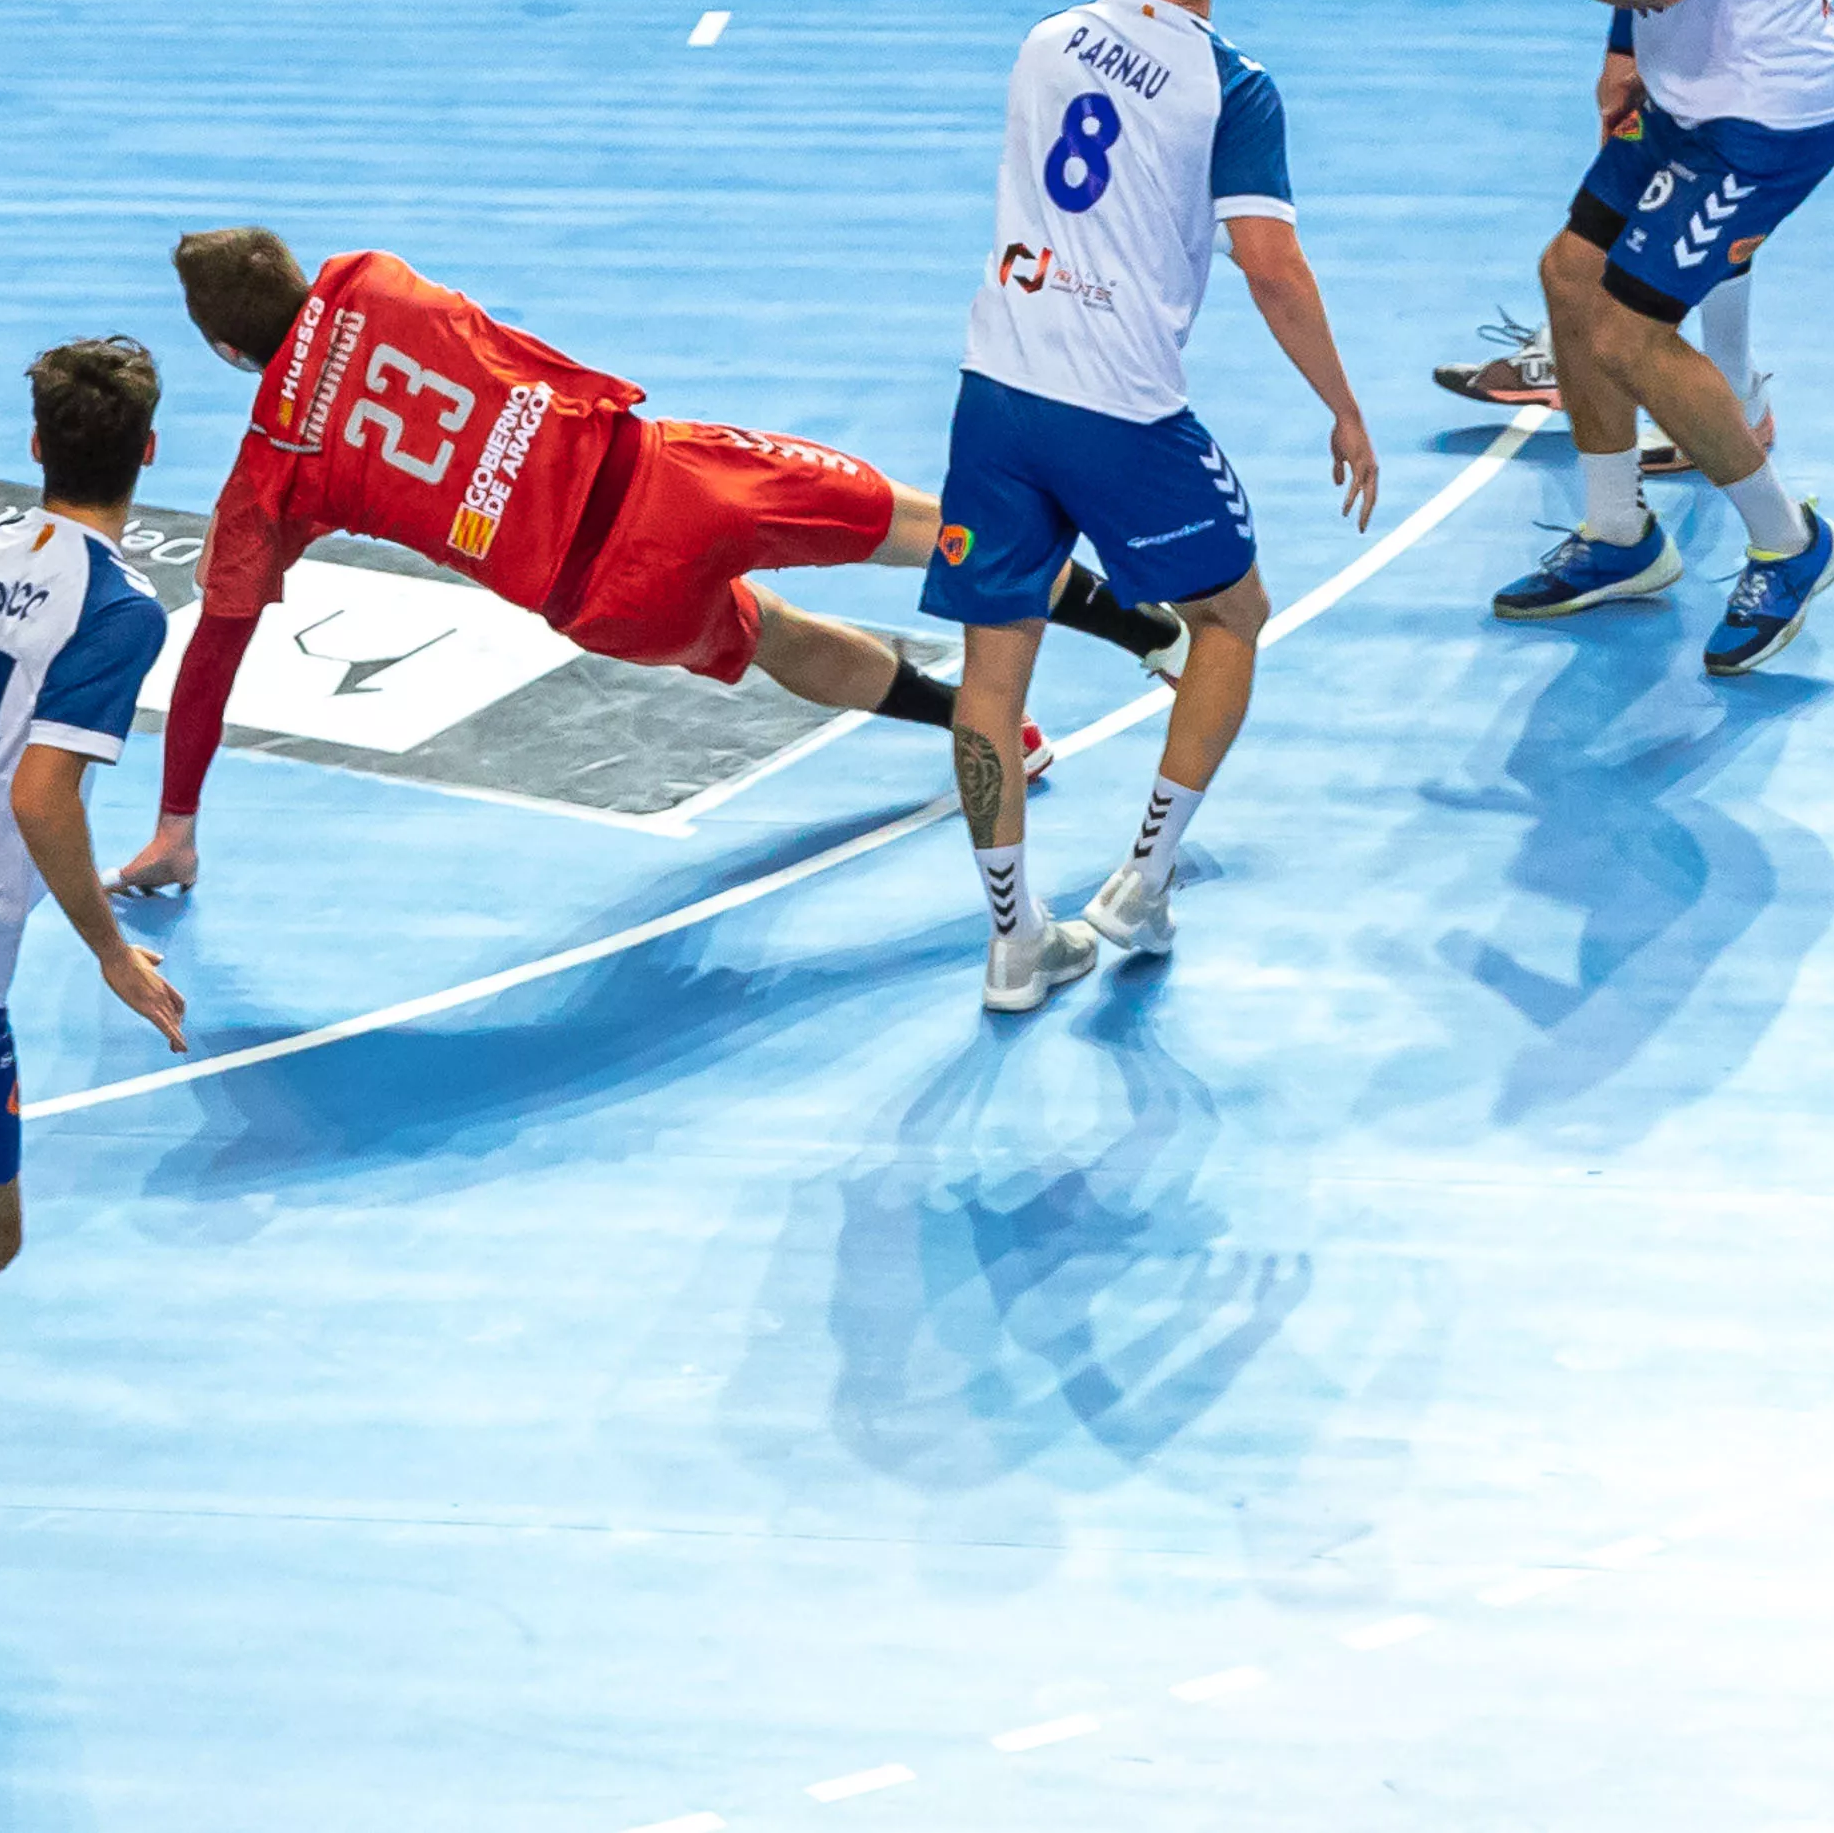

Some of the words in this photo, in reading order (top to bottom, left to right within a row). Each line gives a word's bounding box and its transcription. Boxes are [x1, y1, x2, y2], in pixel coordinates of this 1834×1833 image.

[1064, 26, 1171, 100] P.ARNAU
[1044, 92, 1122, 214] 8
[281, 296, 325, 401] Huesca
[344, 343, 475, 485] 23
[464, 385, 531, 509] GOBIERNO
[483, 478, 513, 517] DE
